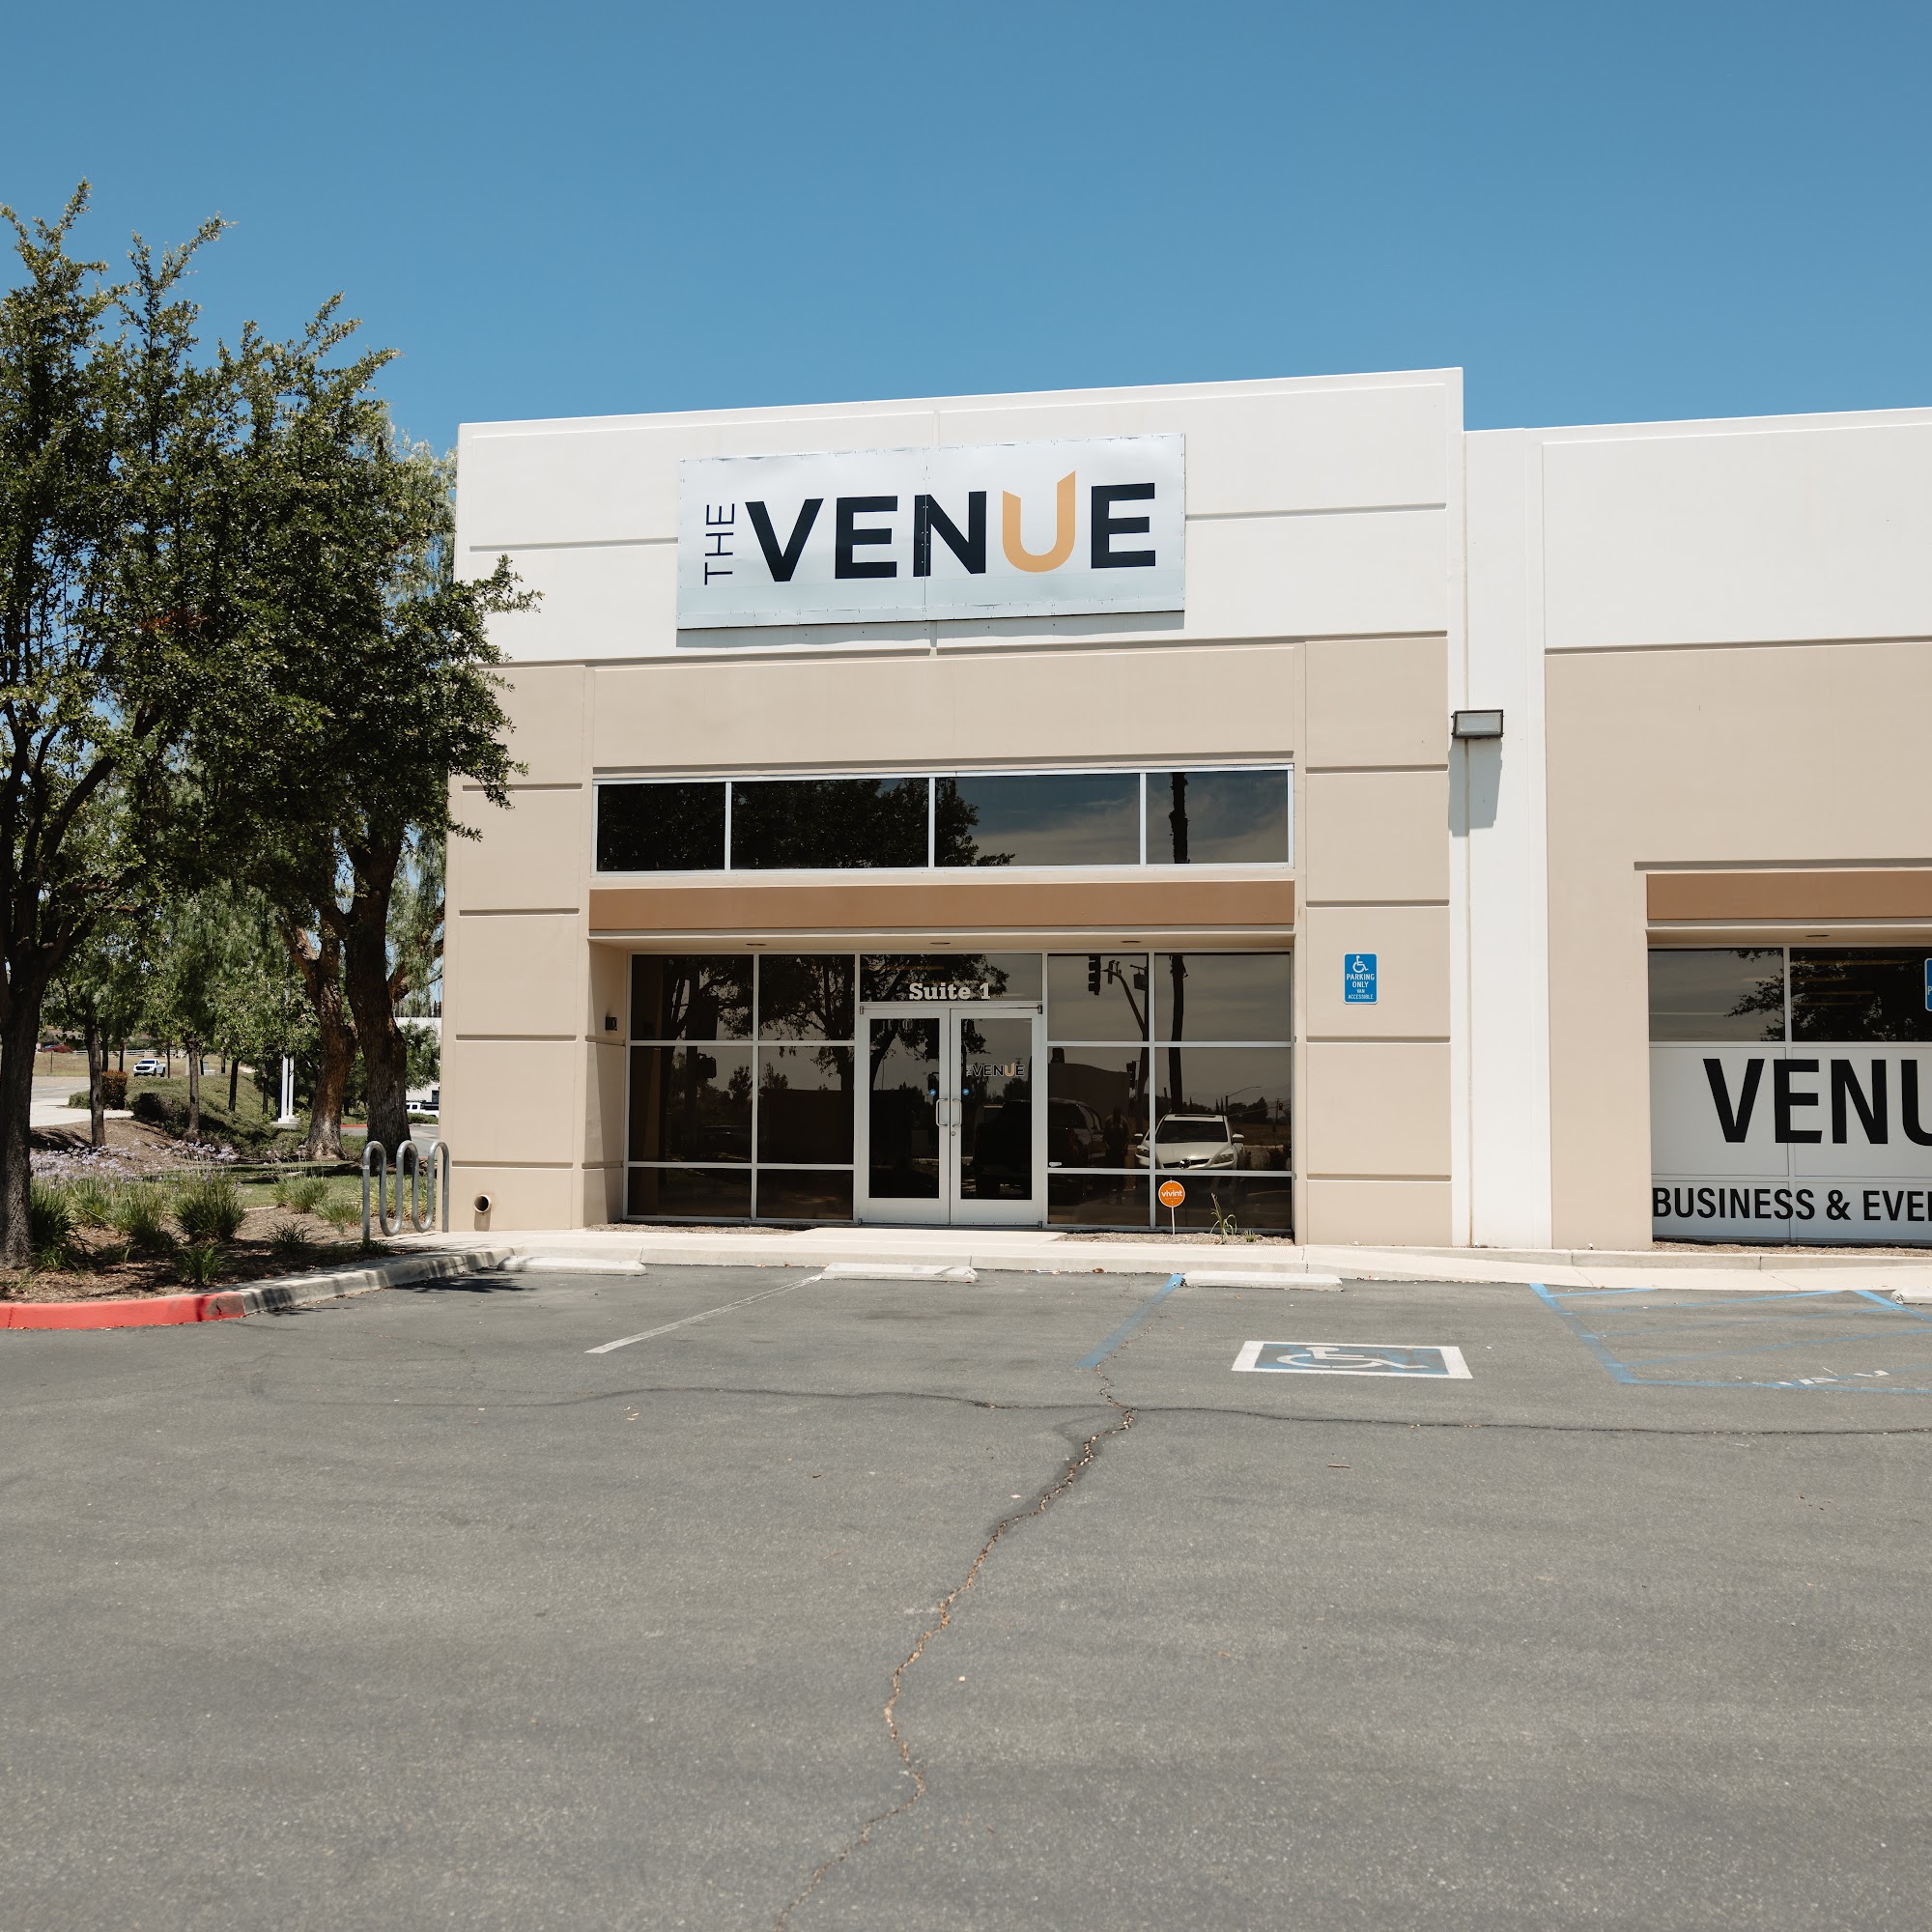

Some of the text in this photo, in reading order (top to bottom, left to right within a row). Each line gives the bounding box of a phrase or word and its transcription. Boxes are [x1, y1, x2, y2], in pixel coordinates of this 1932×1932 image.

[703, 502, 735, 585] THE
[745, 470, 1156, 582] VENUE
[909, 982, 990, 1000] Suite 1
[971, 1063, 1025, 1077] VENUE
[1652, 1187, 1932, 1222] BUSINESS & EVE
